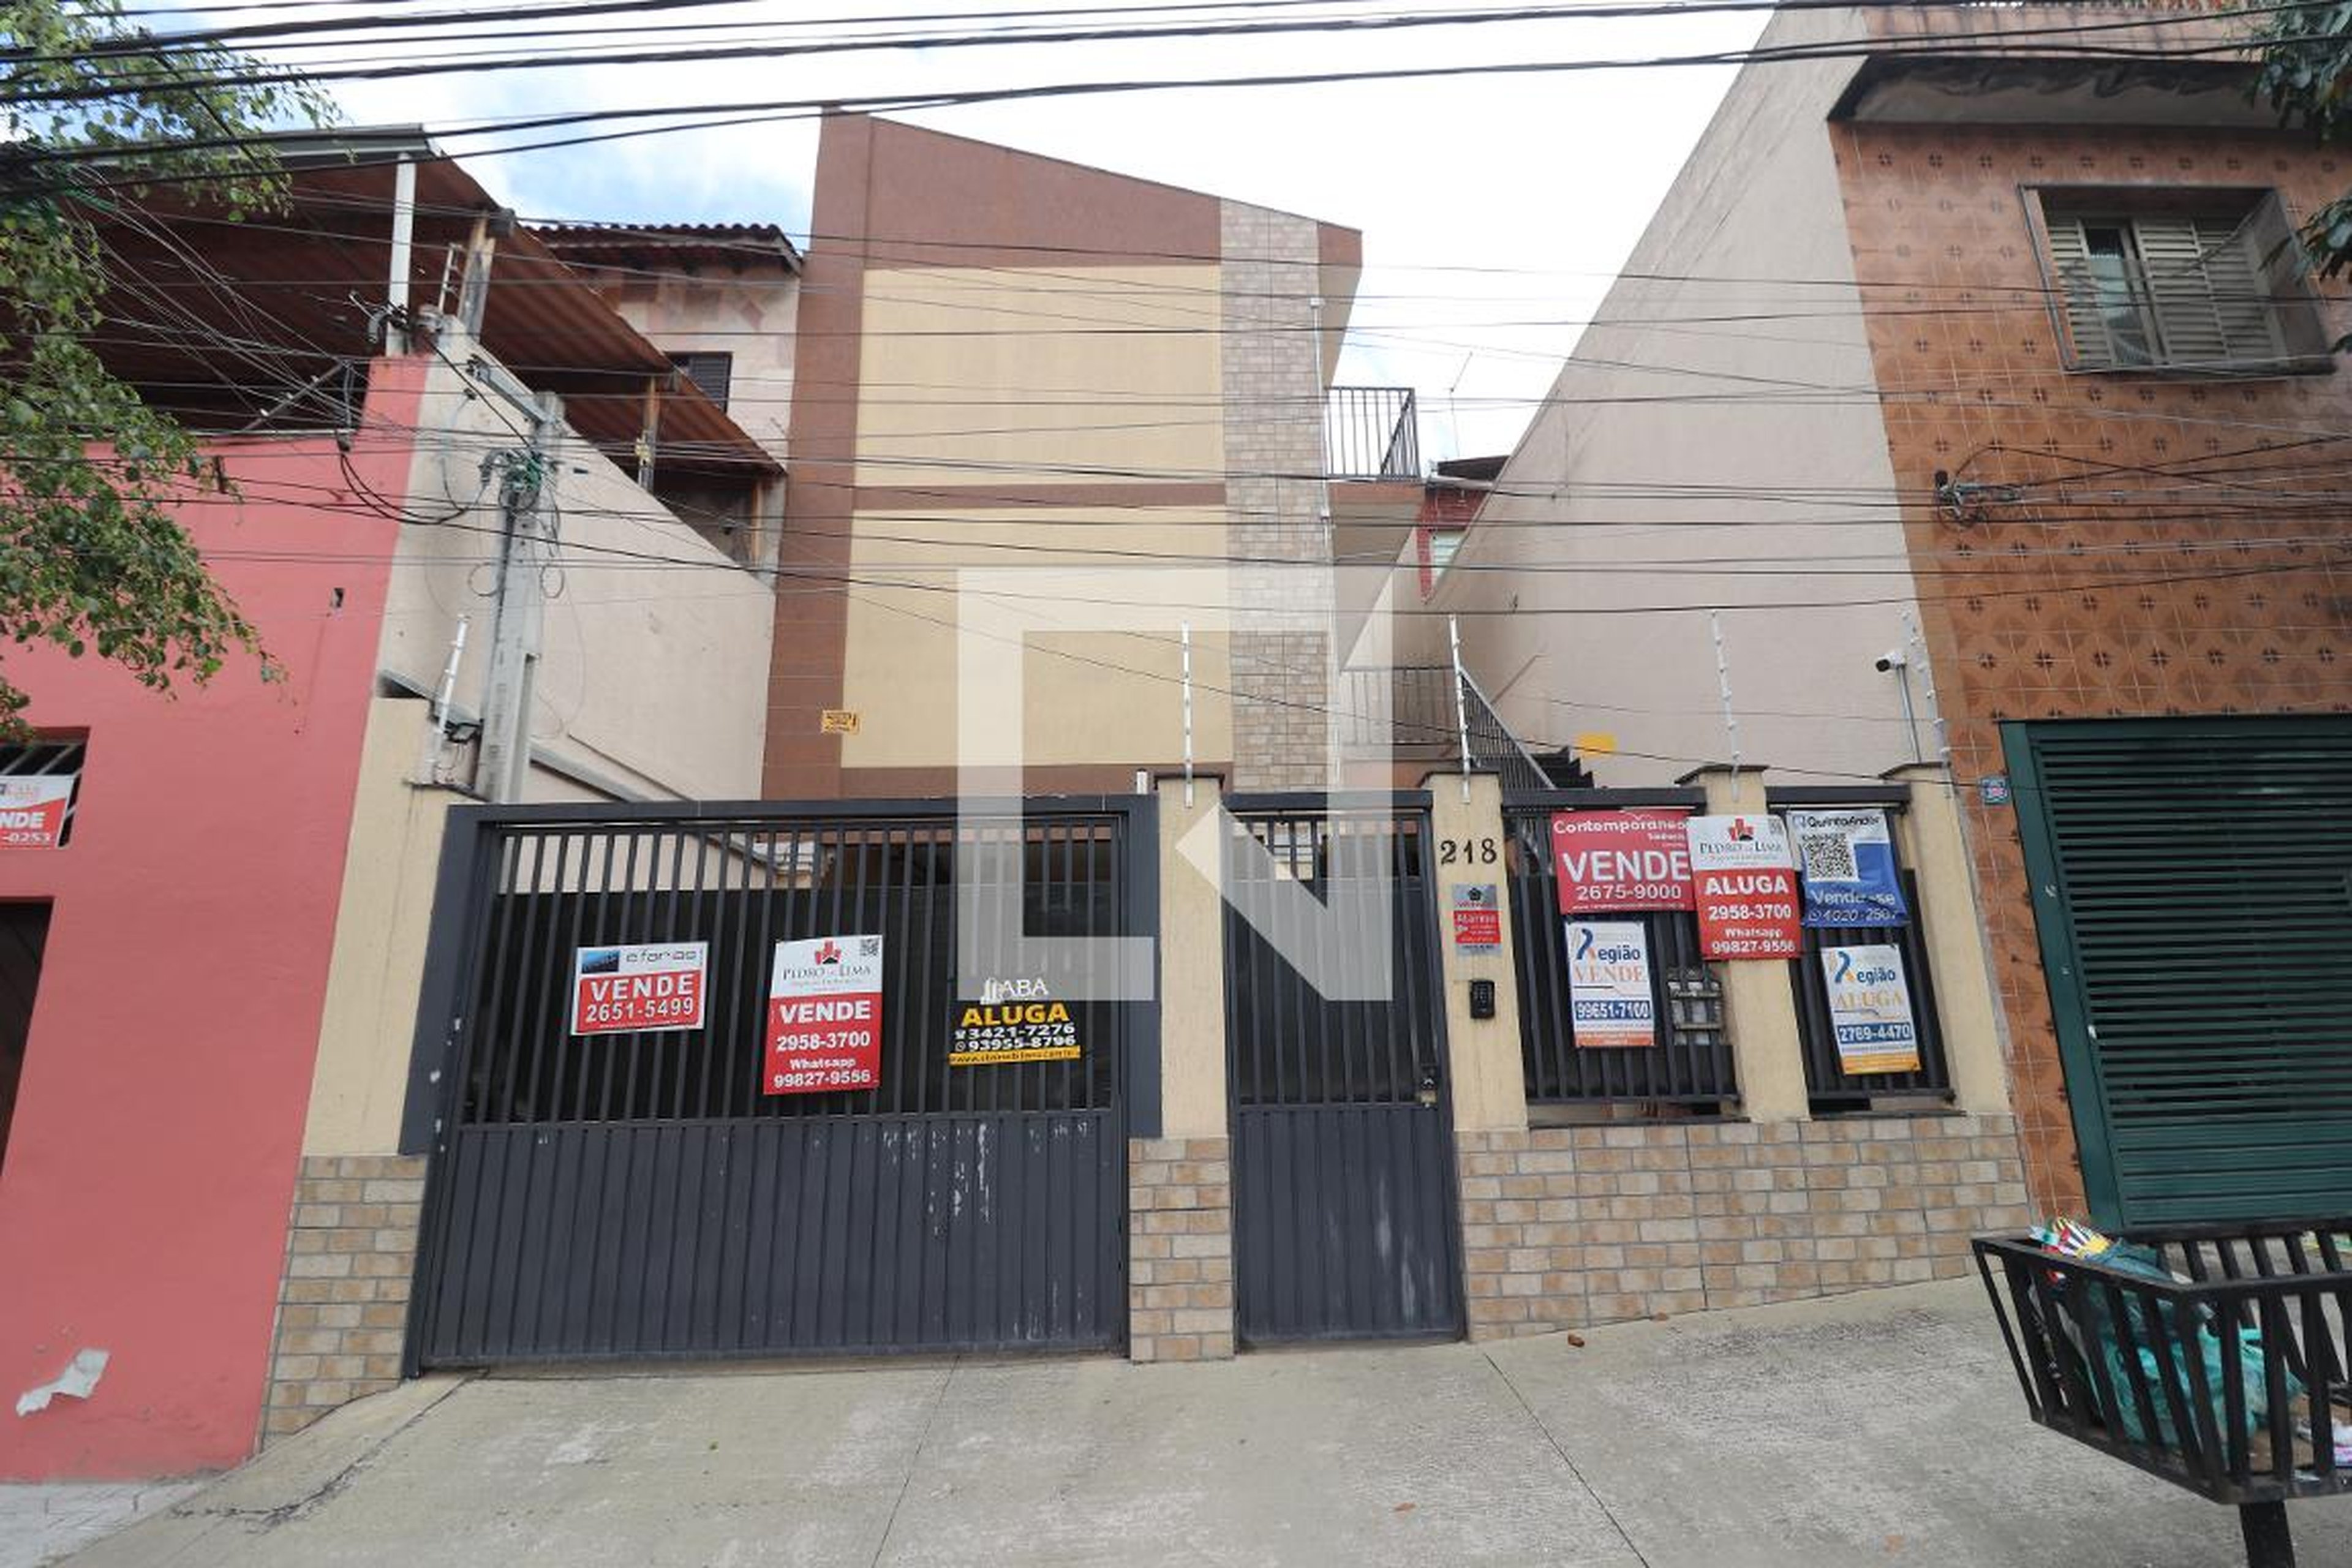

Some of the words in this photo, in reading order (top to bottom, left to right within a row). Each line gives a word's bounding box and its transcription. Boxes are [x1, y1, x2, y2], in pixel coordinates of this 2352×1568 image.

[1441, 838, 1497, 865] 218
[1562, 851, 1691, 883] VENDE
[1575, 884, 1682, 900] 2675-9000
[1705, 876, 1789, 895] ALUGA
[1708, 903, 1792, 921] 2958-3700
[1725, 928, 1782, 939] Whatsapp
[1574, 966, 1643, 981] VENDE
[590, 974, 694, 1001] VENDE
[586, 998, 694, 1023] 2651-5499
[780, 1000, 871, 1024] VENDE
[962, 1003, 1069, 1027] ALUGA
[968, 1022, 1075, 1039] 3421-7276
[776, 1031, 870, 1052] 2958-3700
[790, 1057, 856, 1071] Whatsapp
